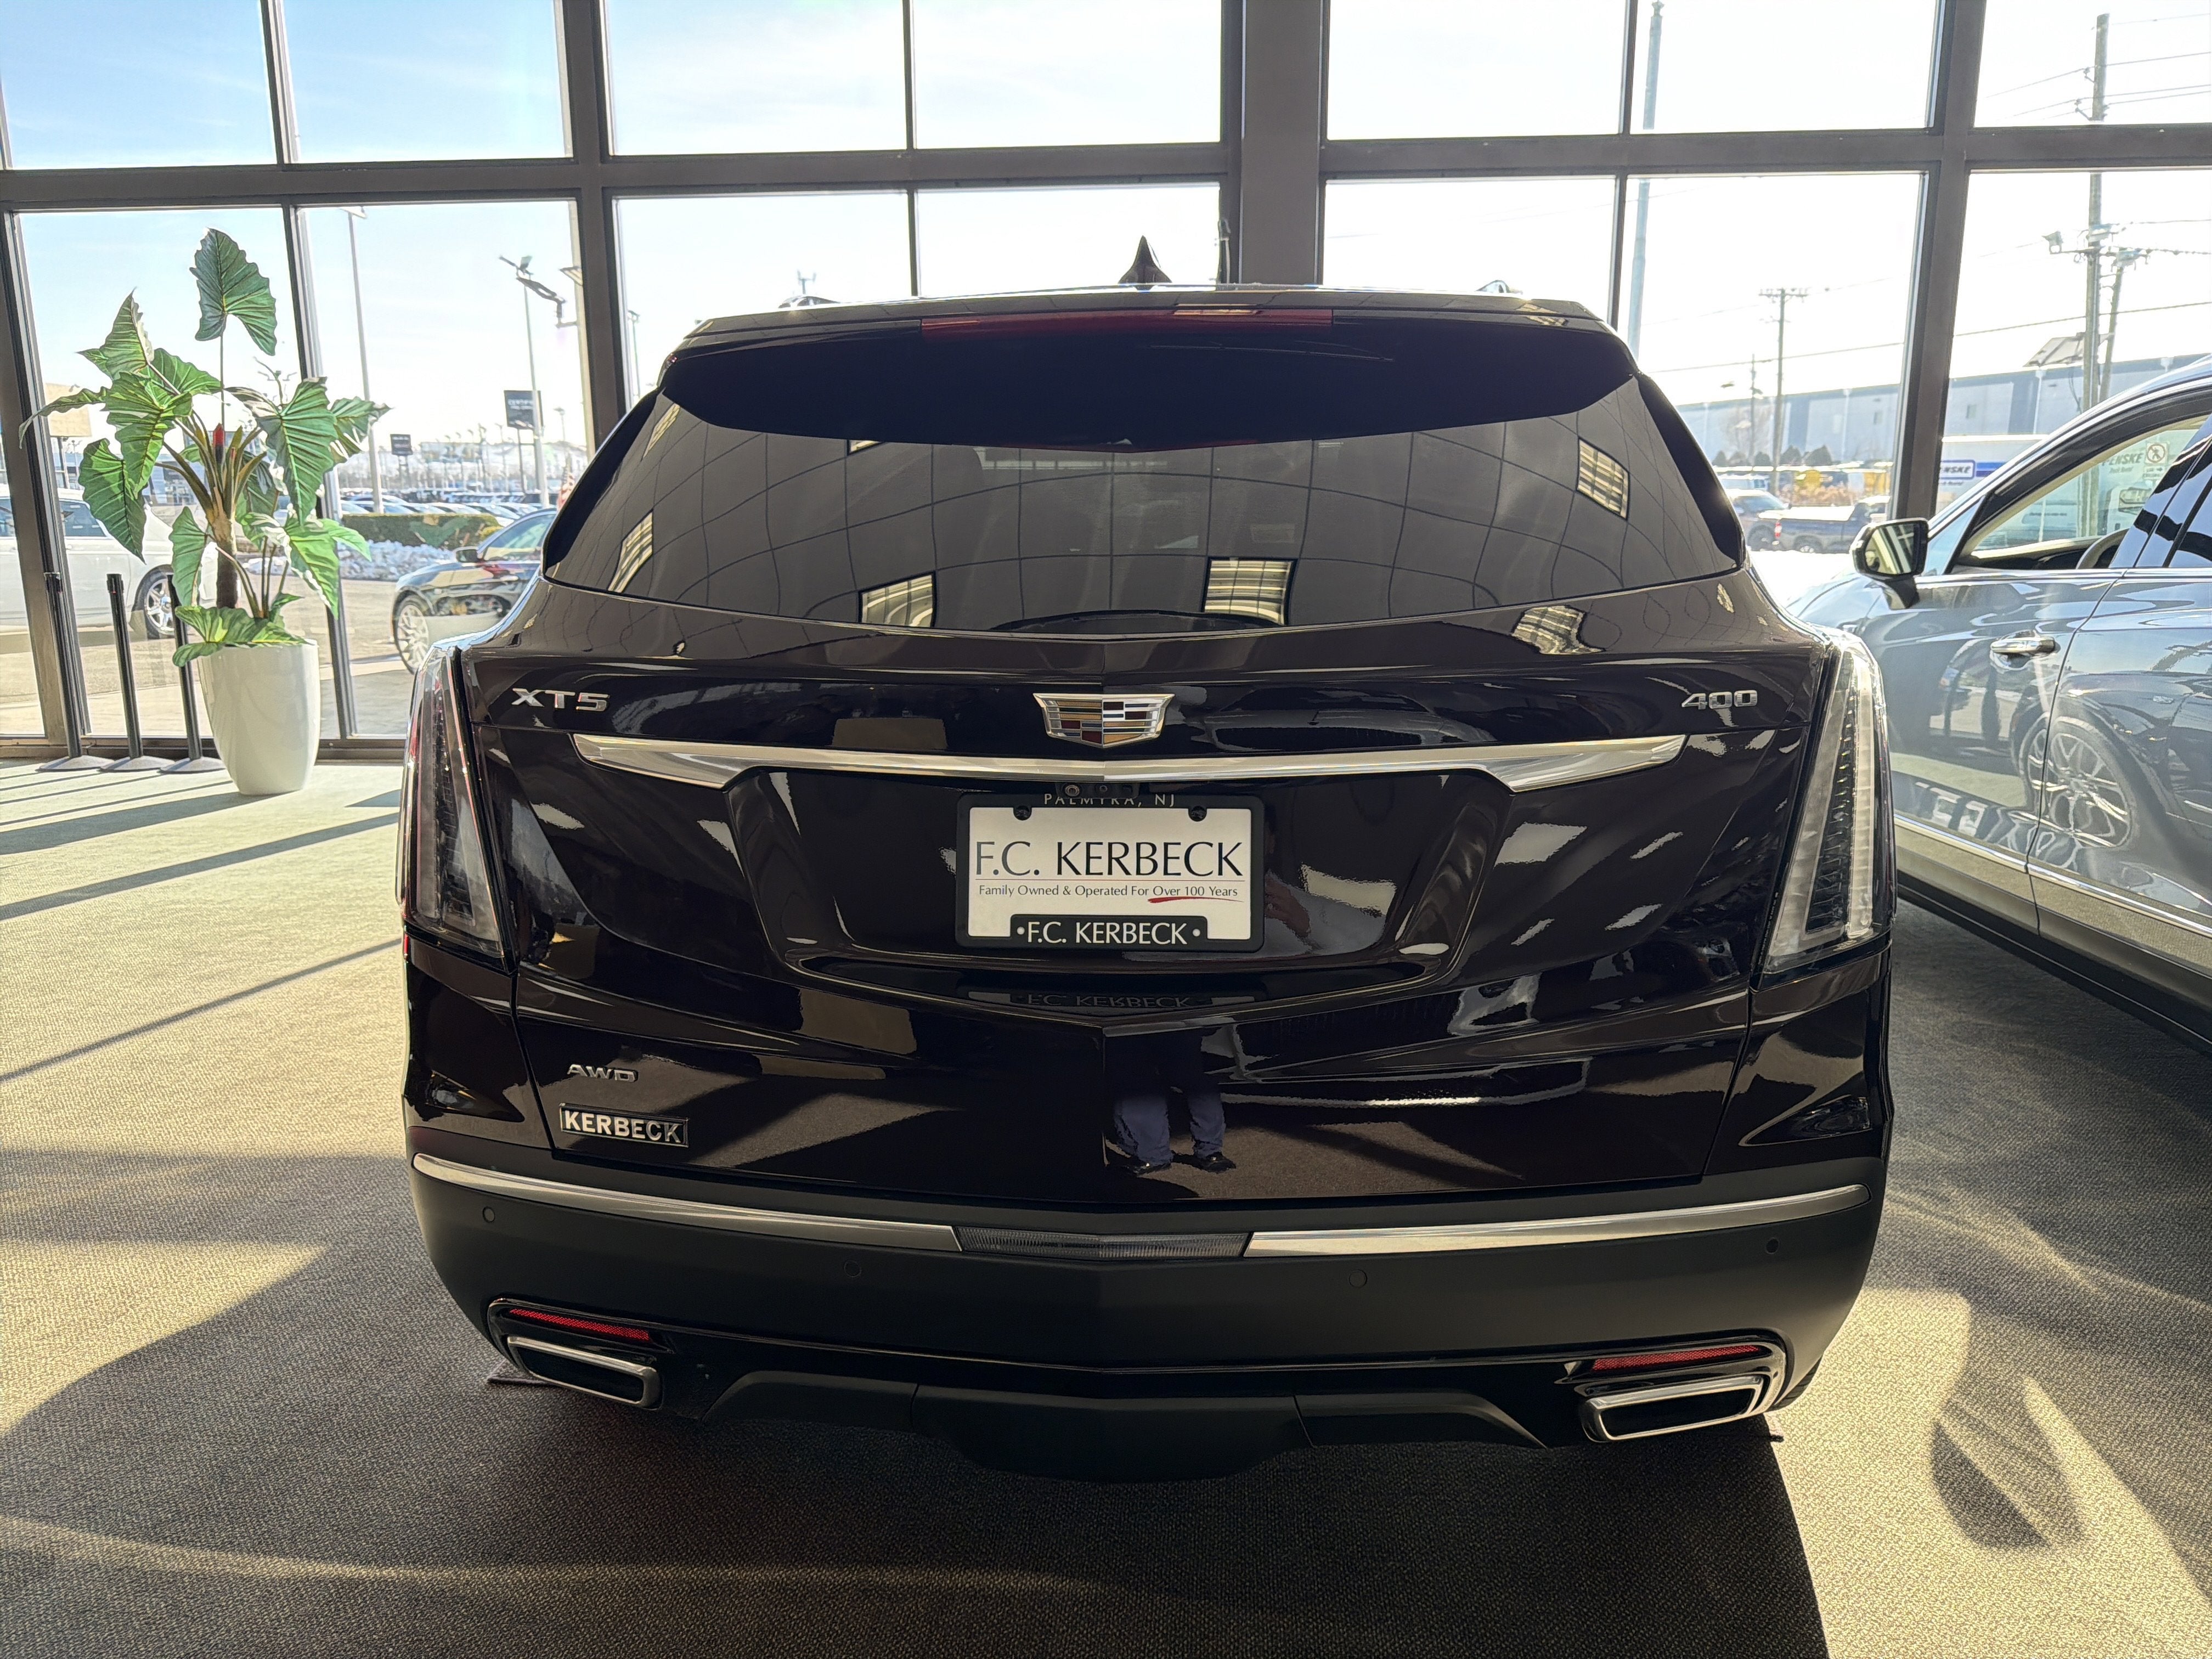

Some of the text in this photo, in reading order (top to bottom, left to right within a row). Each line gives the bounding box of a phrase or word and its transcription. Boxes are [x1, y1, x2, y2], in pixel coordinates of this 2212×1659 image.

[511, 688, 610, 712] XT5
[1681, 690, 1757, 710] 400
[1155, 794, 1174, 807] NJ
[976, 841, 1244, 877] F.C. KERBECK
[979, 884, 1238, 898] Family Owned & Operated For Over 100 Years
[1027, 921, 1188, 944] F.C. KERBECK
[567, 1064, 638, 1082] AWD
[564, 1109, 682, 1144] KERBECK
